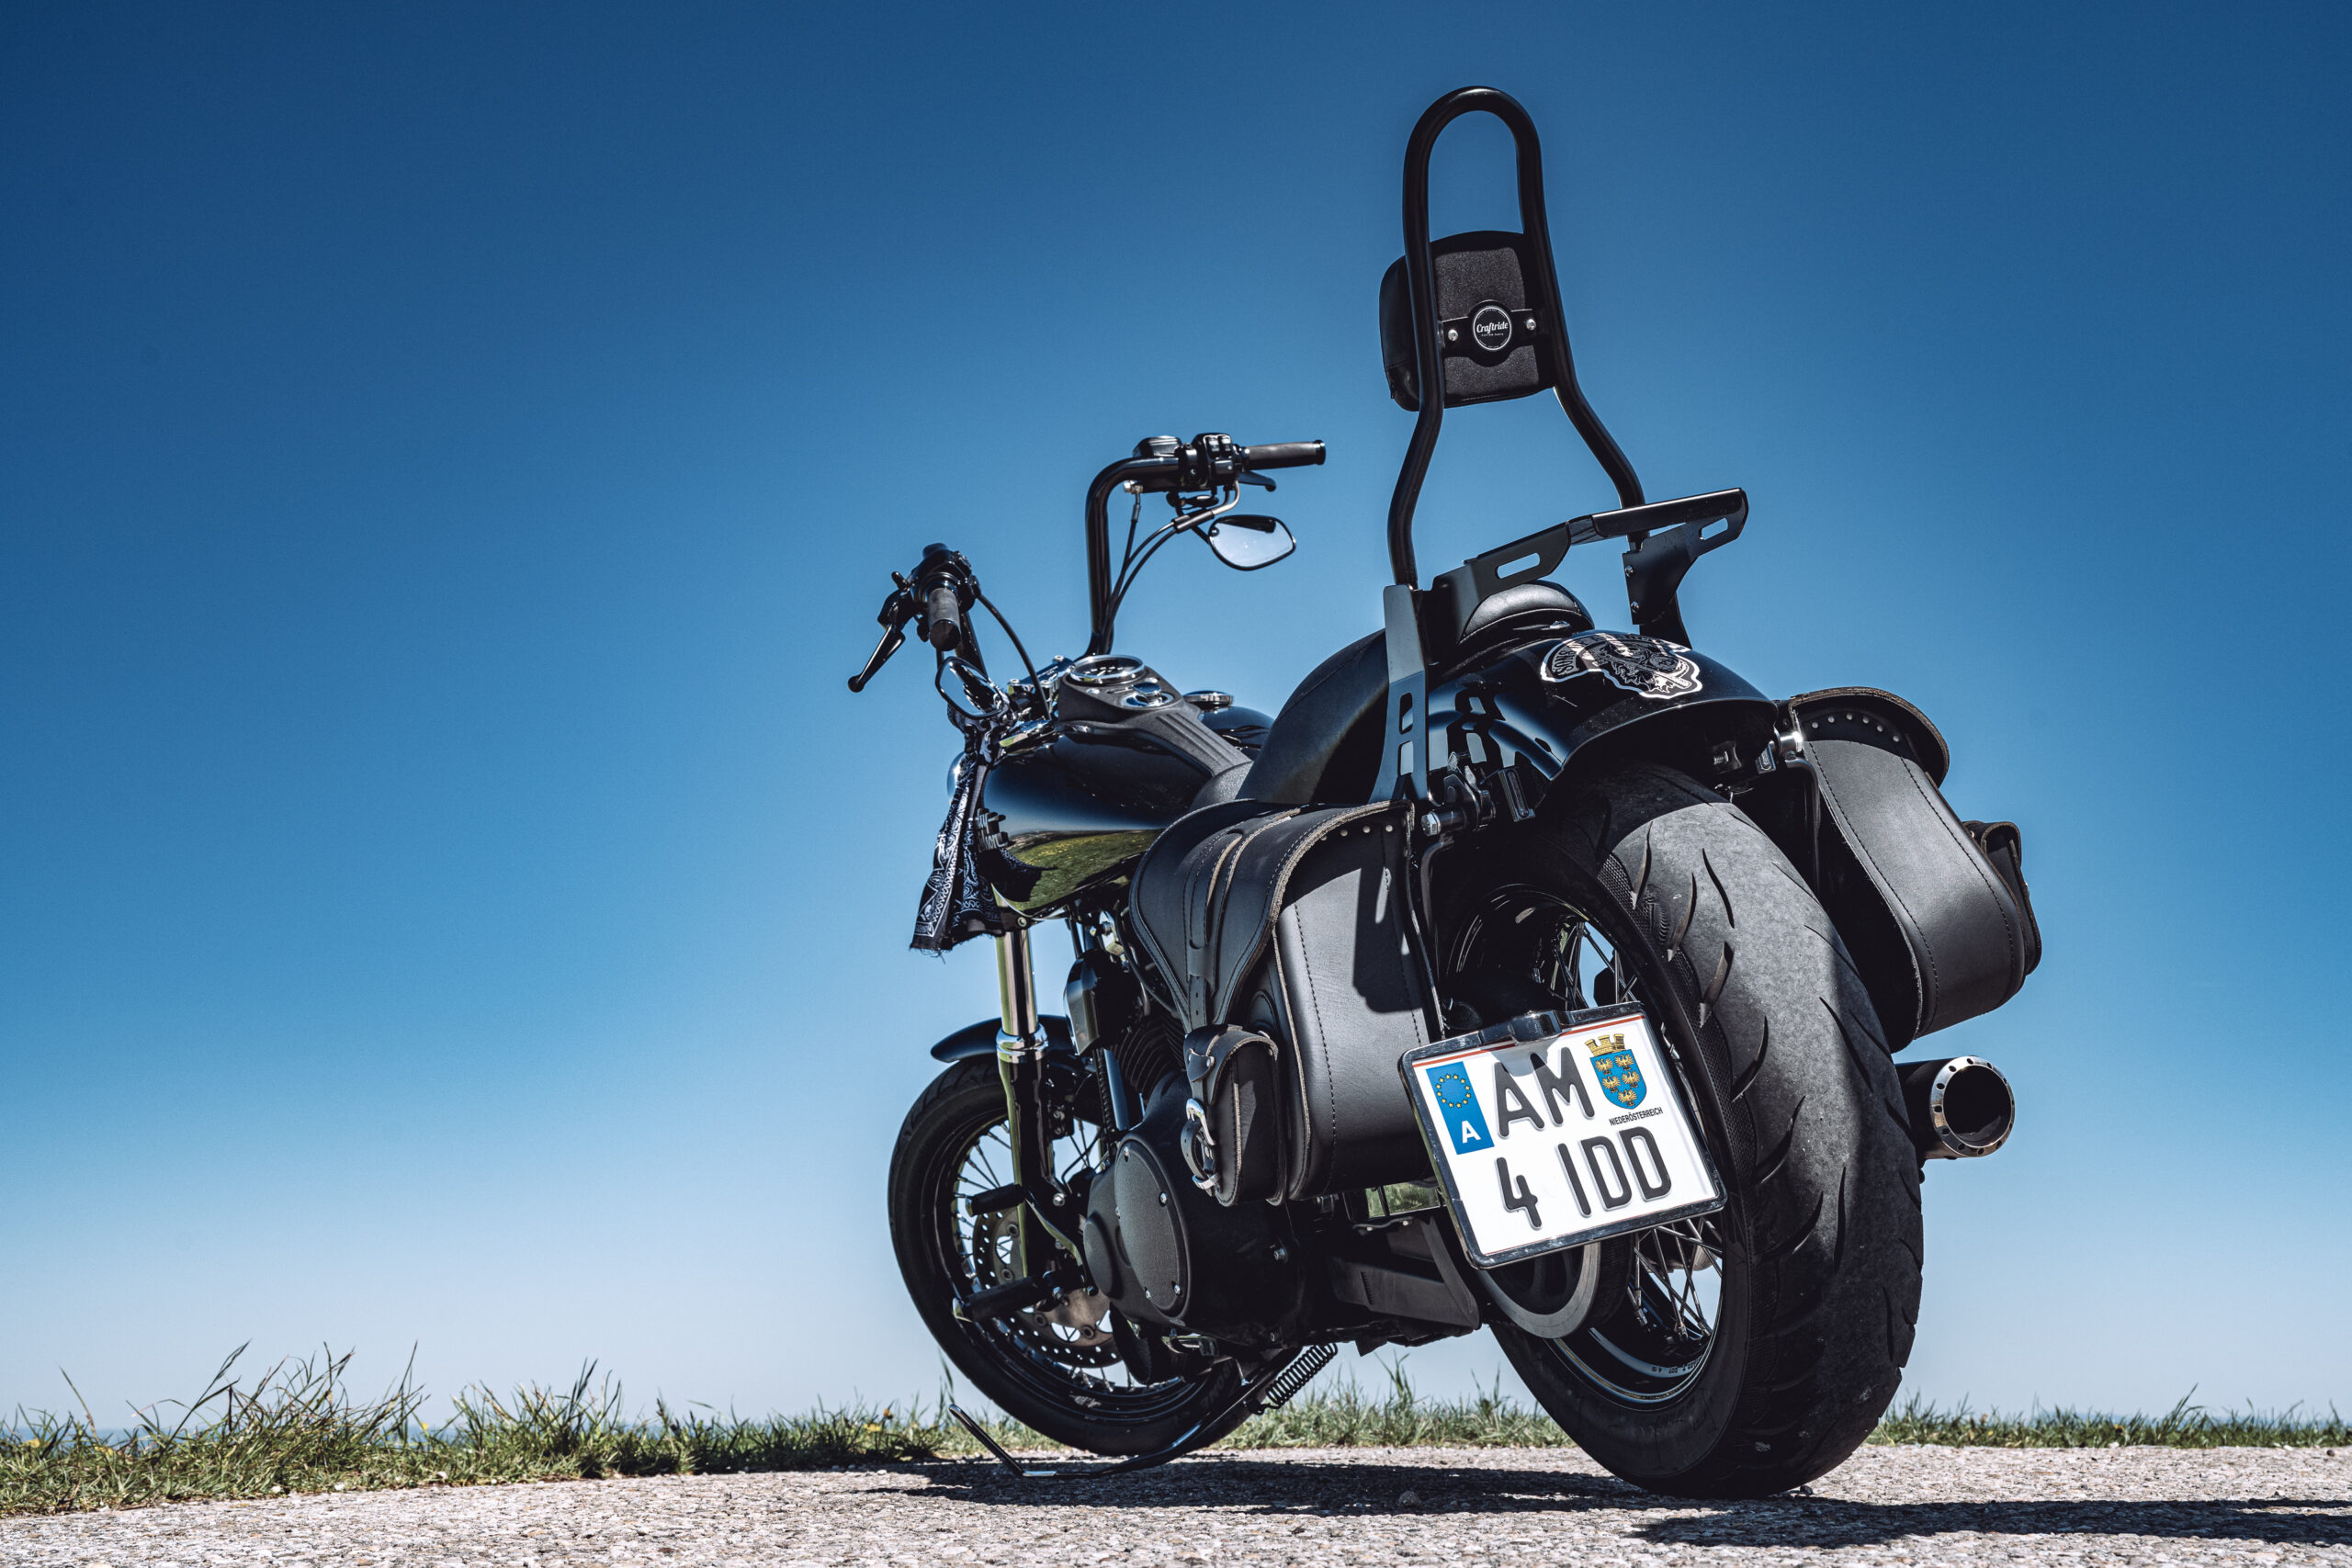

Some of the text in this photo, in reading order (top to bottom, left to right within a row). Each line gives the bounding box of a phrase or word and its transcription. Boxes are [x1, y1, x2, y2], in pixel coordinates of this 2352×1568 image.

[1476, 321, 1509, 333] Craftride
[1553, 649, 1577, 675] SONS
[1493, 1046, 1595, 1138] AM
[1609, 1107, 1664, 1126] NIEDERÖSTERREICH
[1461, 1120, 1481, 1144] A
[1497, 1126, 1672, 1228] 4 IDD
